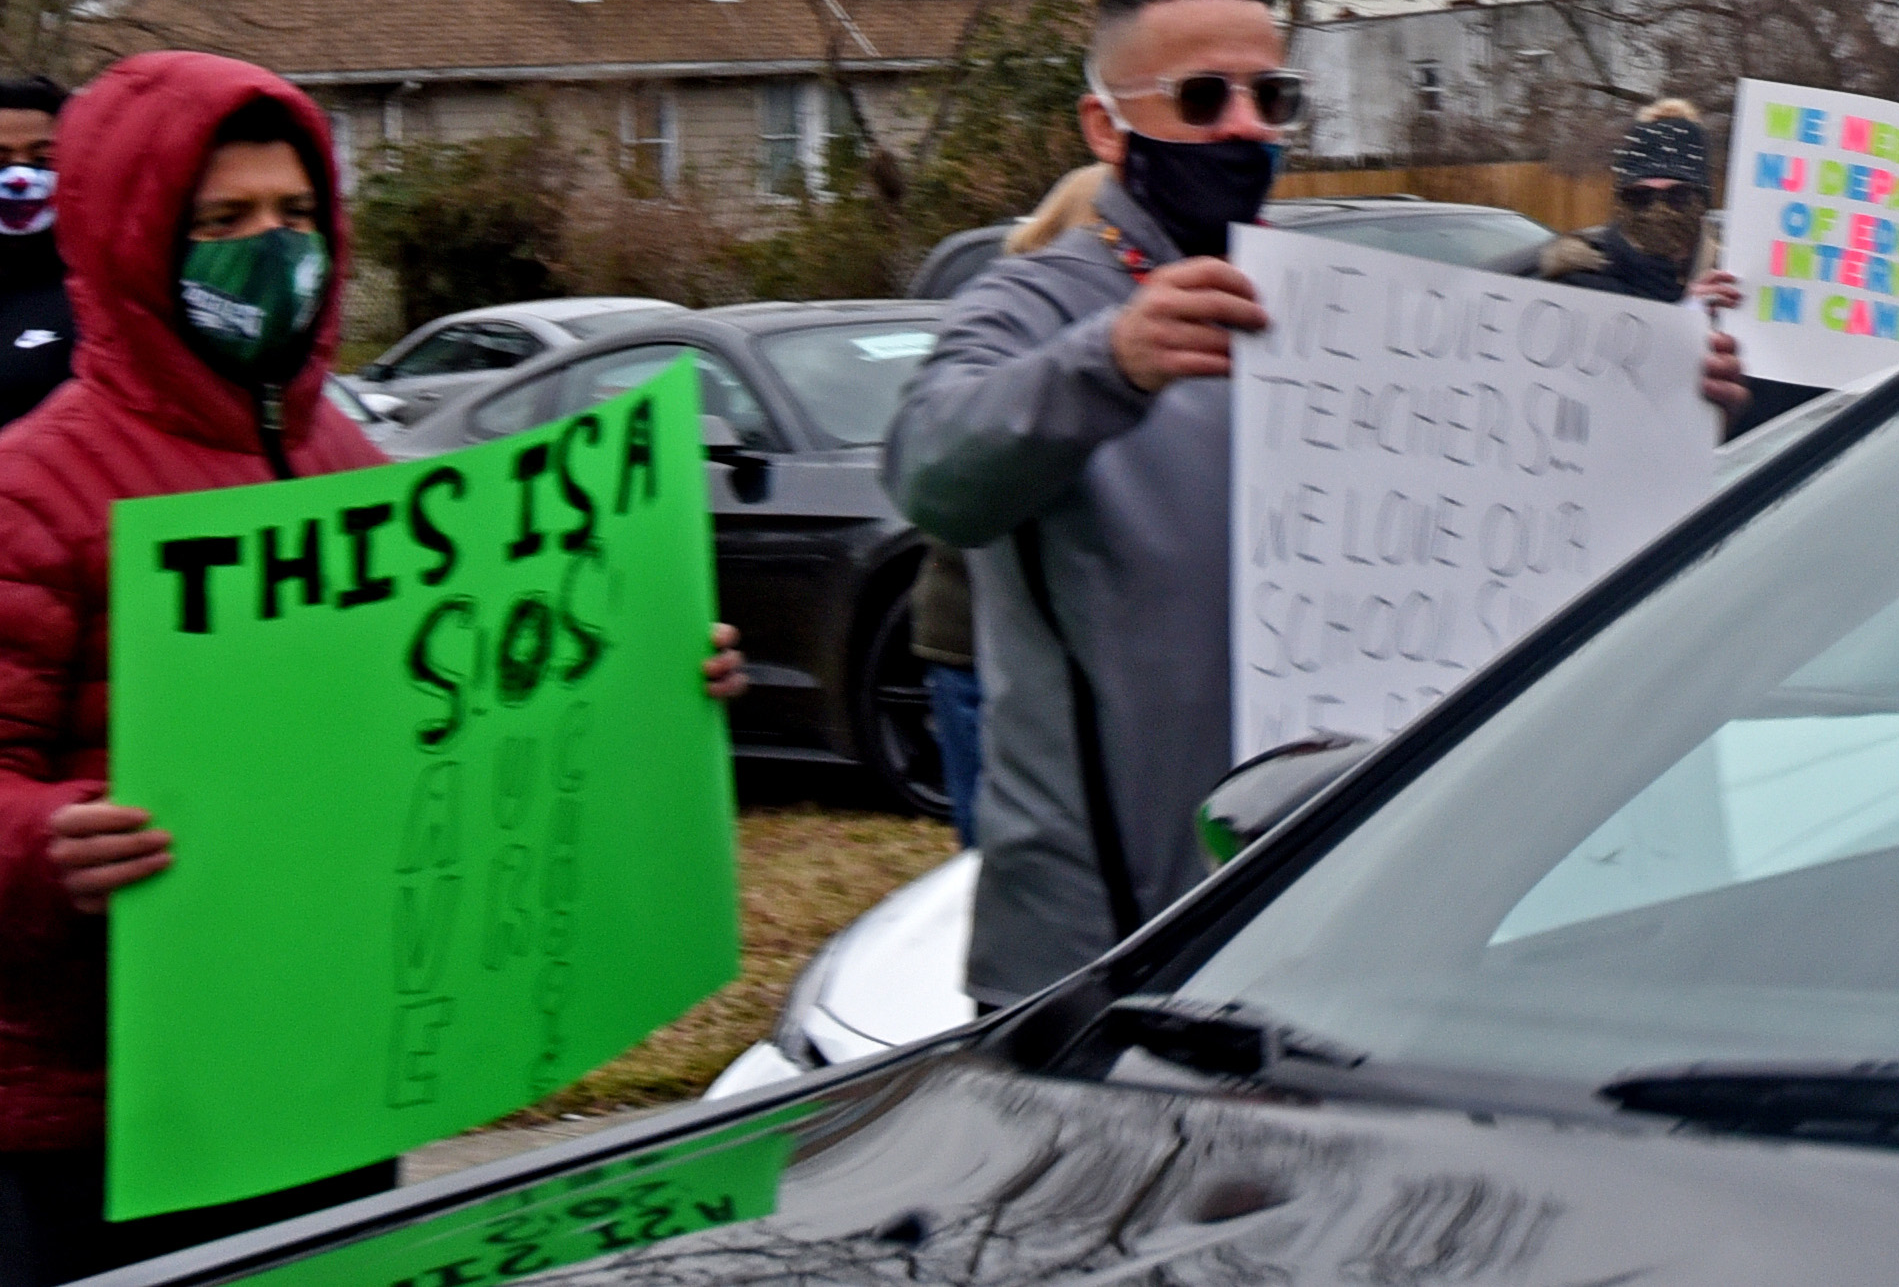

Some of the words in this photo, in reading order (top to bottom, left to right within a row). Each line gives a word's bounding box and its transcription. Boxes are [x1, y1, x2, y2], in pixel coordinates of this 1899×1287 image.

[1781, 201, 1839, 242] OF
[156, 465, 466, 635] THIS
[504, 415, 602, 560] IS
[612, 395, 662, 516] A
